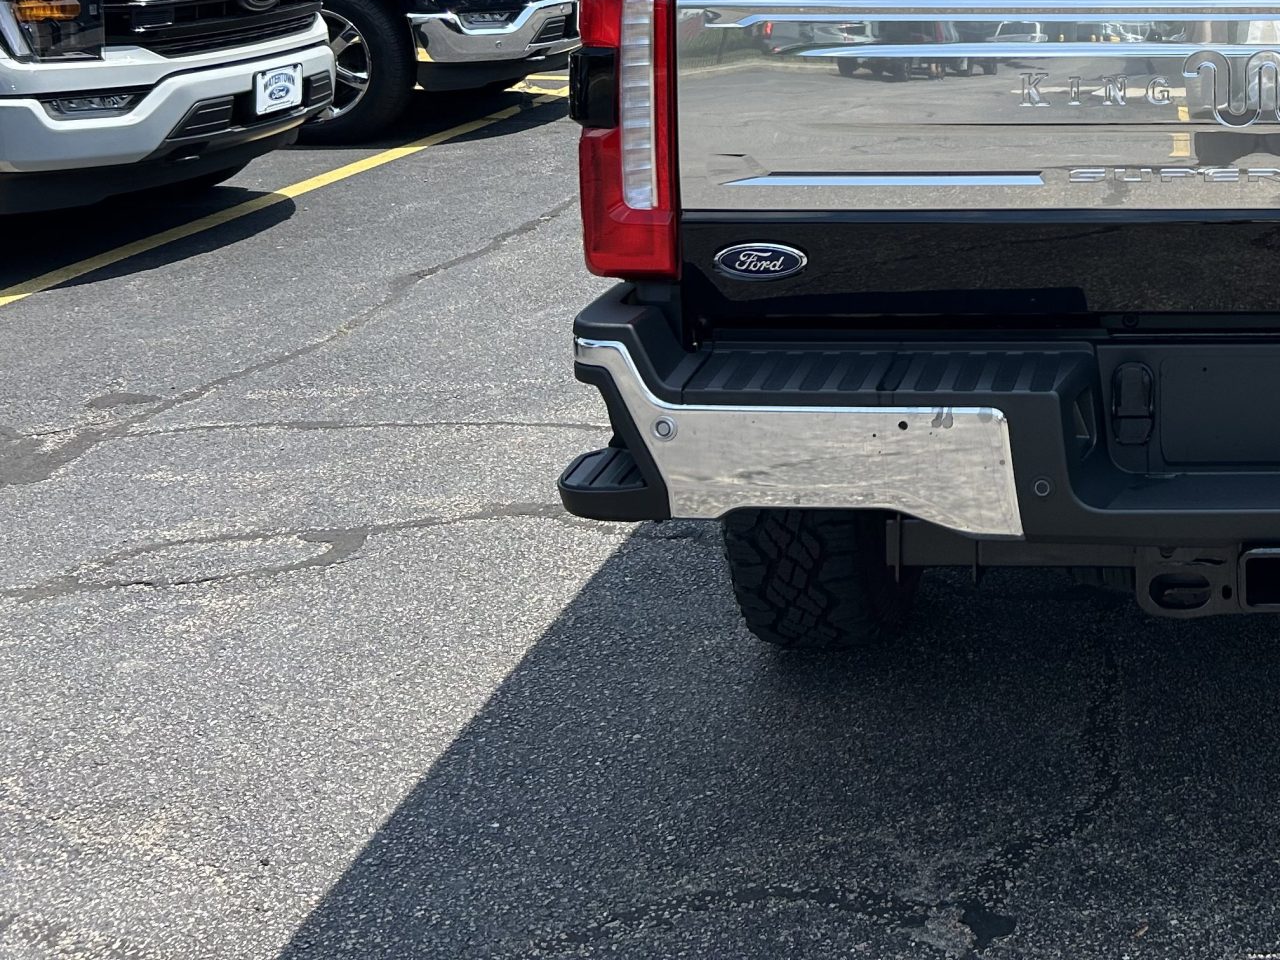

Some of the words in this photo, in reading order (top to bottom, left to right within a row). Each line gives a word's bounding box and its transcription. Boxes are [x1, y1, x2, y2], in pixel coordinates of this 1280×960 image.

[264, 72, 296, 93] WATERTOWN
[1018, 72, 1174, 107] KING
[735, 250, 785, 271] Ford
